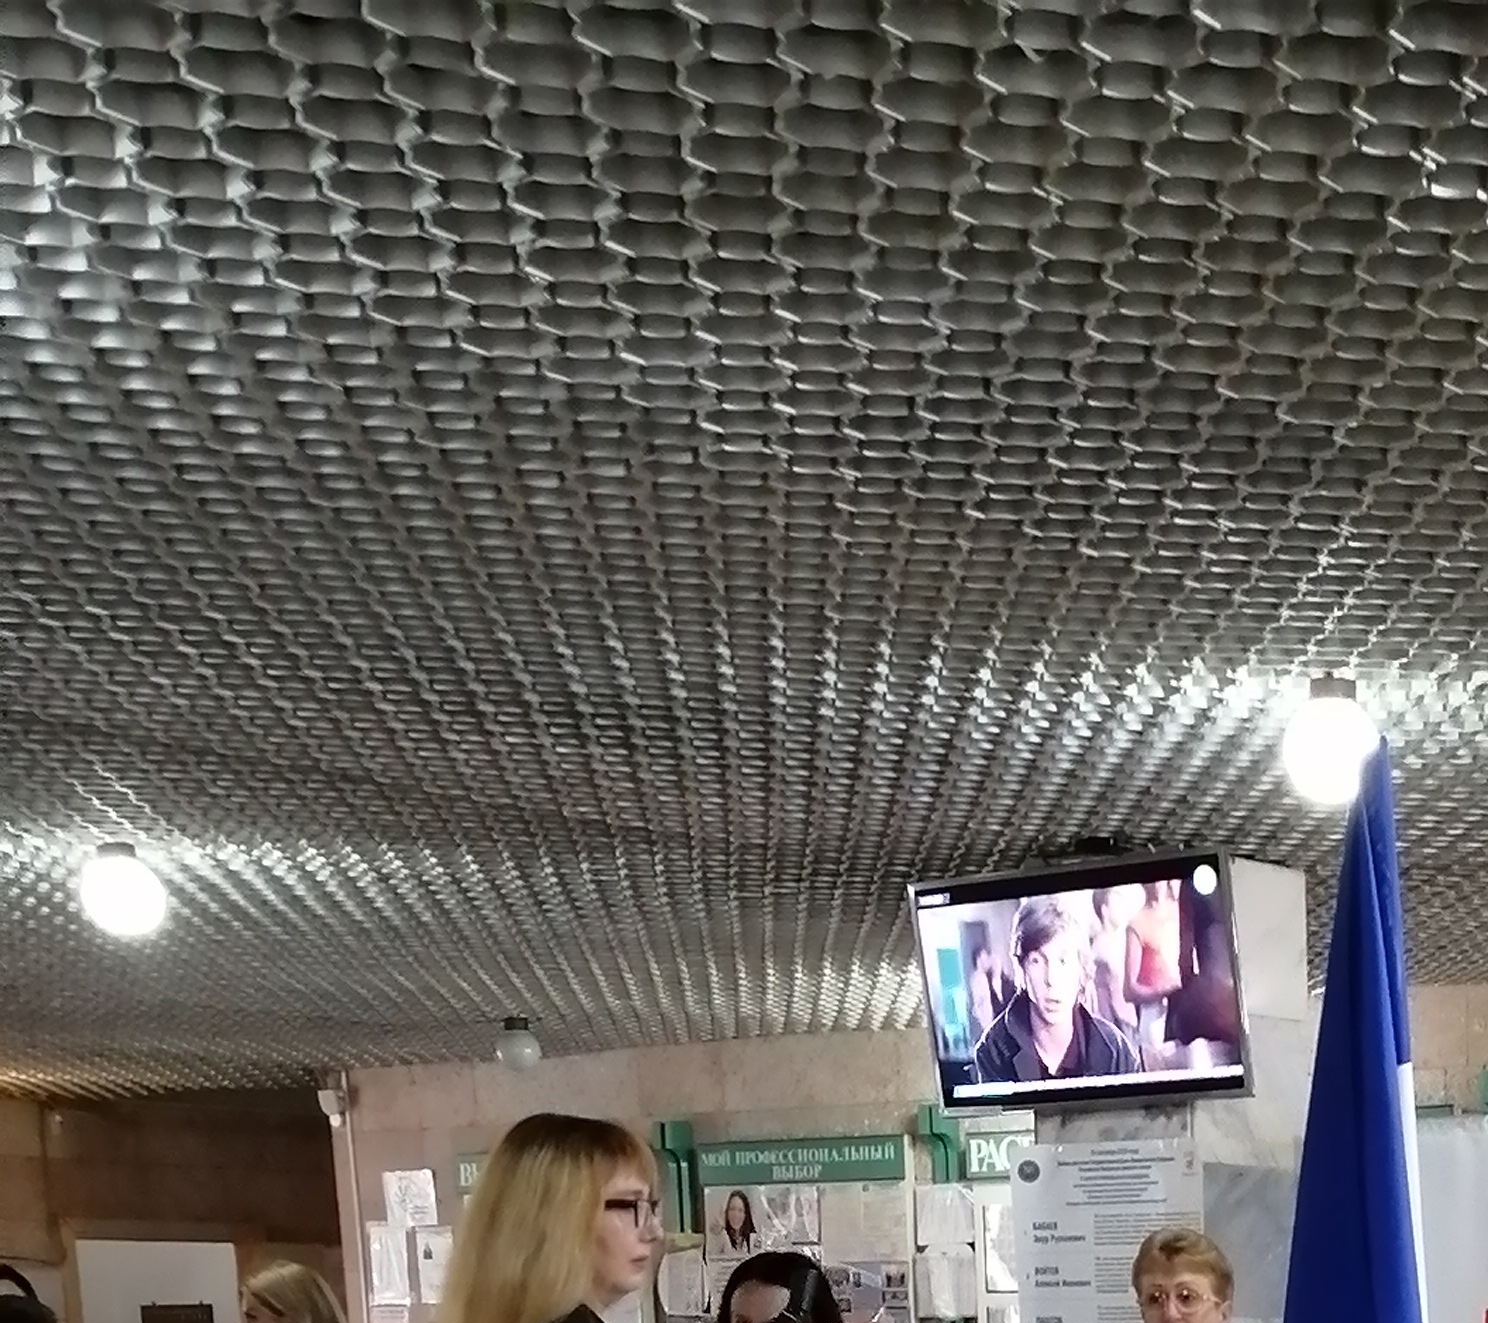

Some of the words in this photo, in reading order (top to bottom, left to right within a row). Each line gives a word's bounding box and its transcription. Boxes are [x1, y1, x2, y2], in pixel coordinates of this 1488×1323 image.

[701, 1150, 731, 1167] МОЙ
[735, 1142, 895, 1166] ПРОФЕССИОНАЛЬНЫЙ
[969, 1134, 1034, 1172] РАС
[772, 1164, 822, 1181] ВЫБОР
